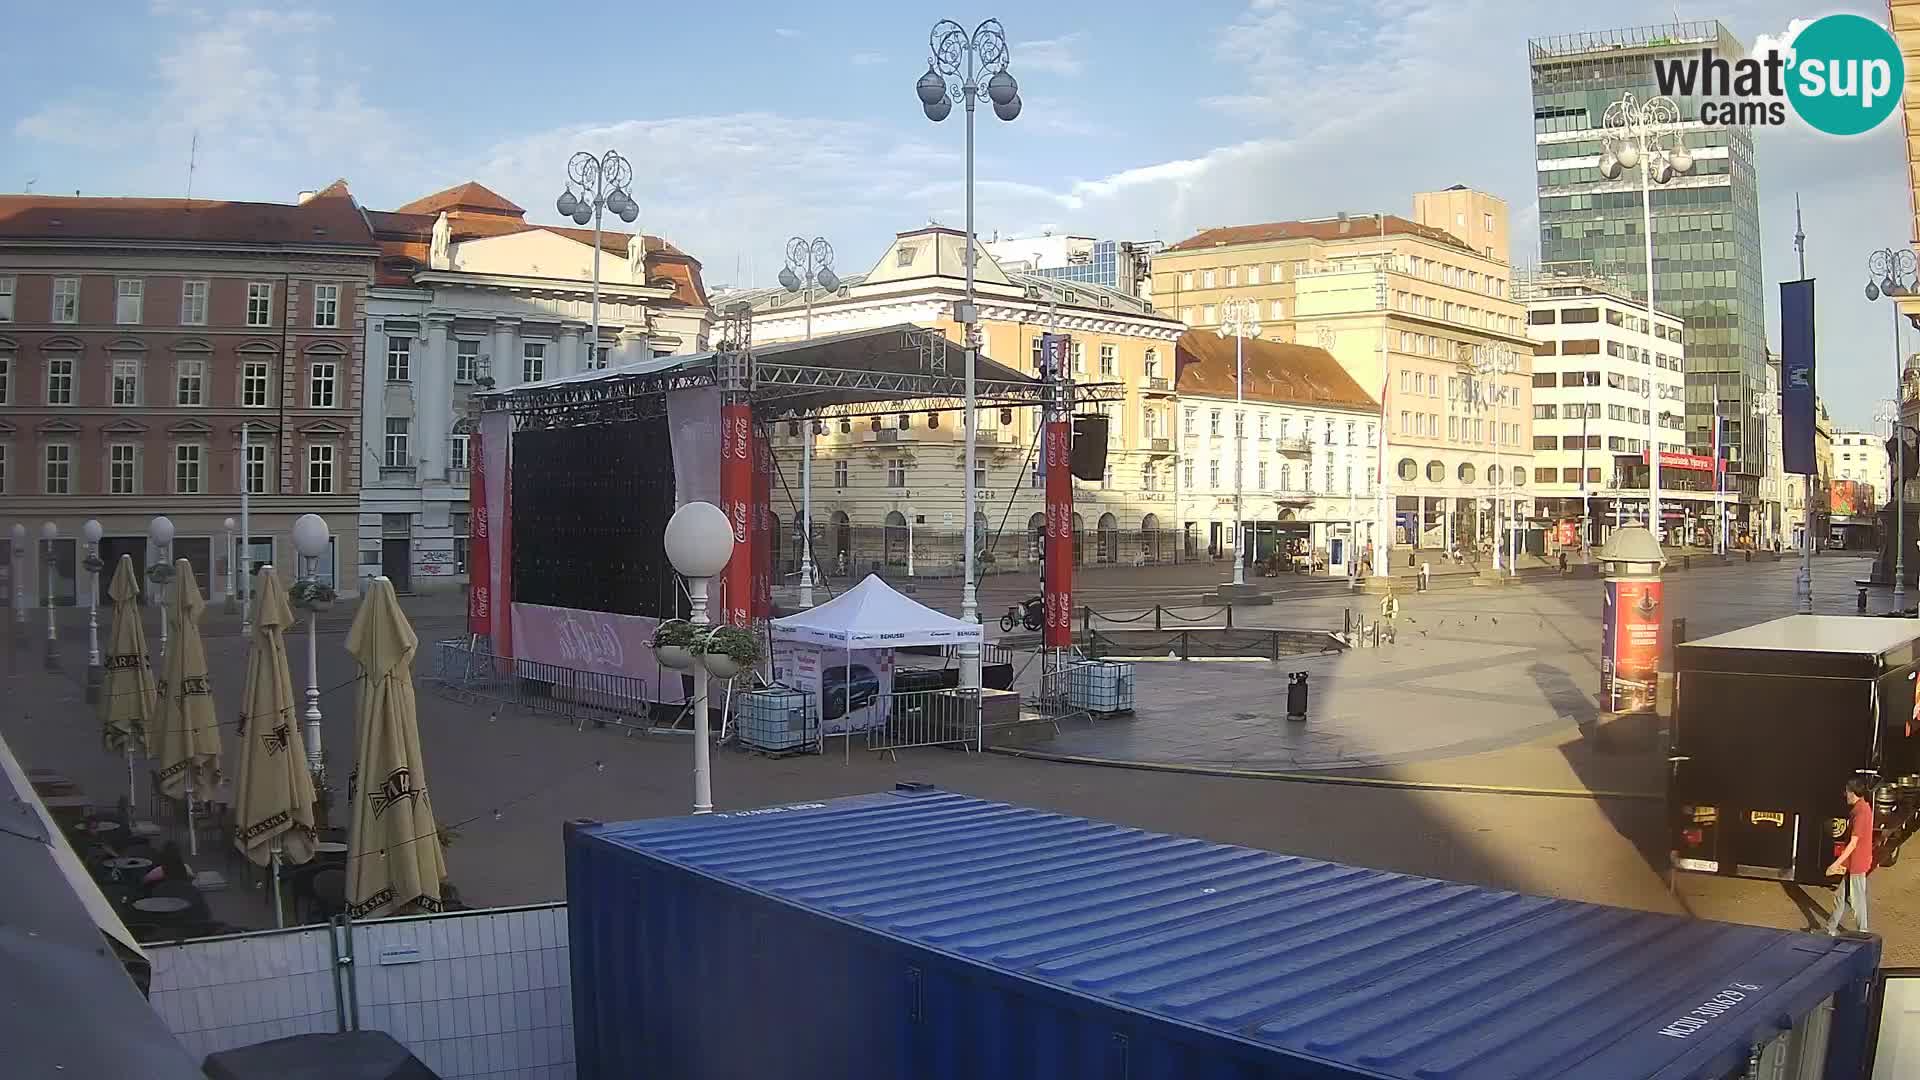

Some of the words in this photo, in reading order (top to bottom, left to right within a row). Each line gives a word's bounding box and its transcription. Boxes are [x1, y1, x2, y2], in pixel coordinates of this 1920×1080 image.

[960, 489, 996, 499] SGER
[1657, 1016, 1708, 1039] MCDU
[1691, 990, 1747, 1018] 300629
